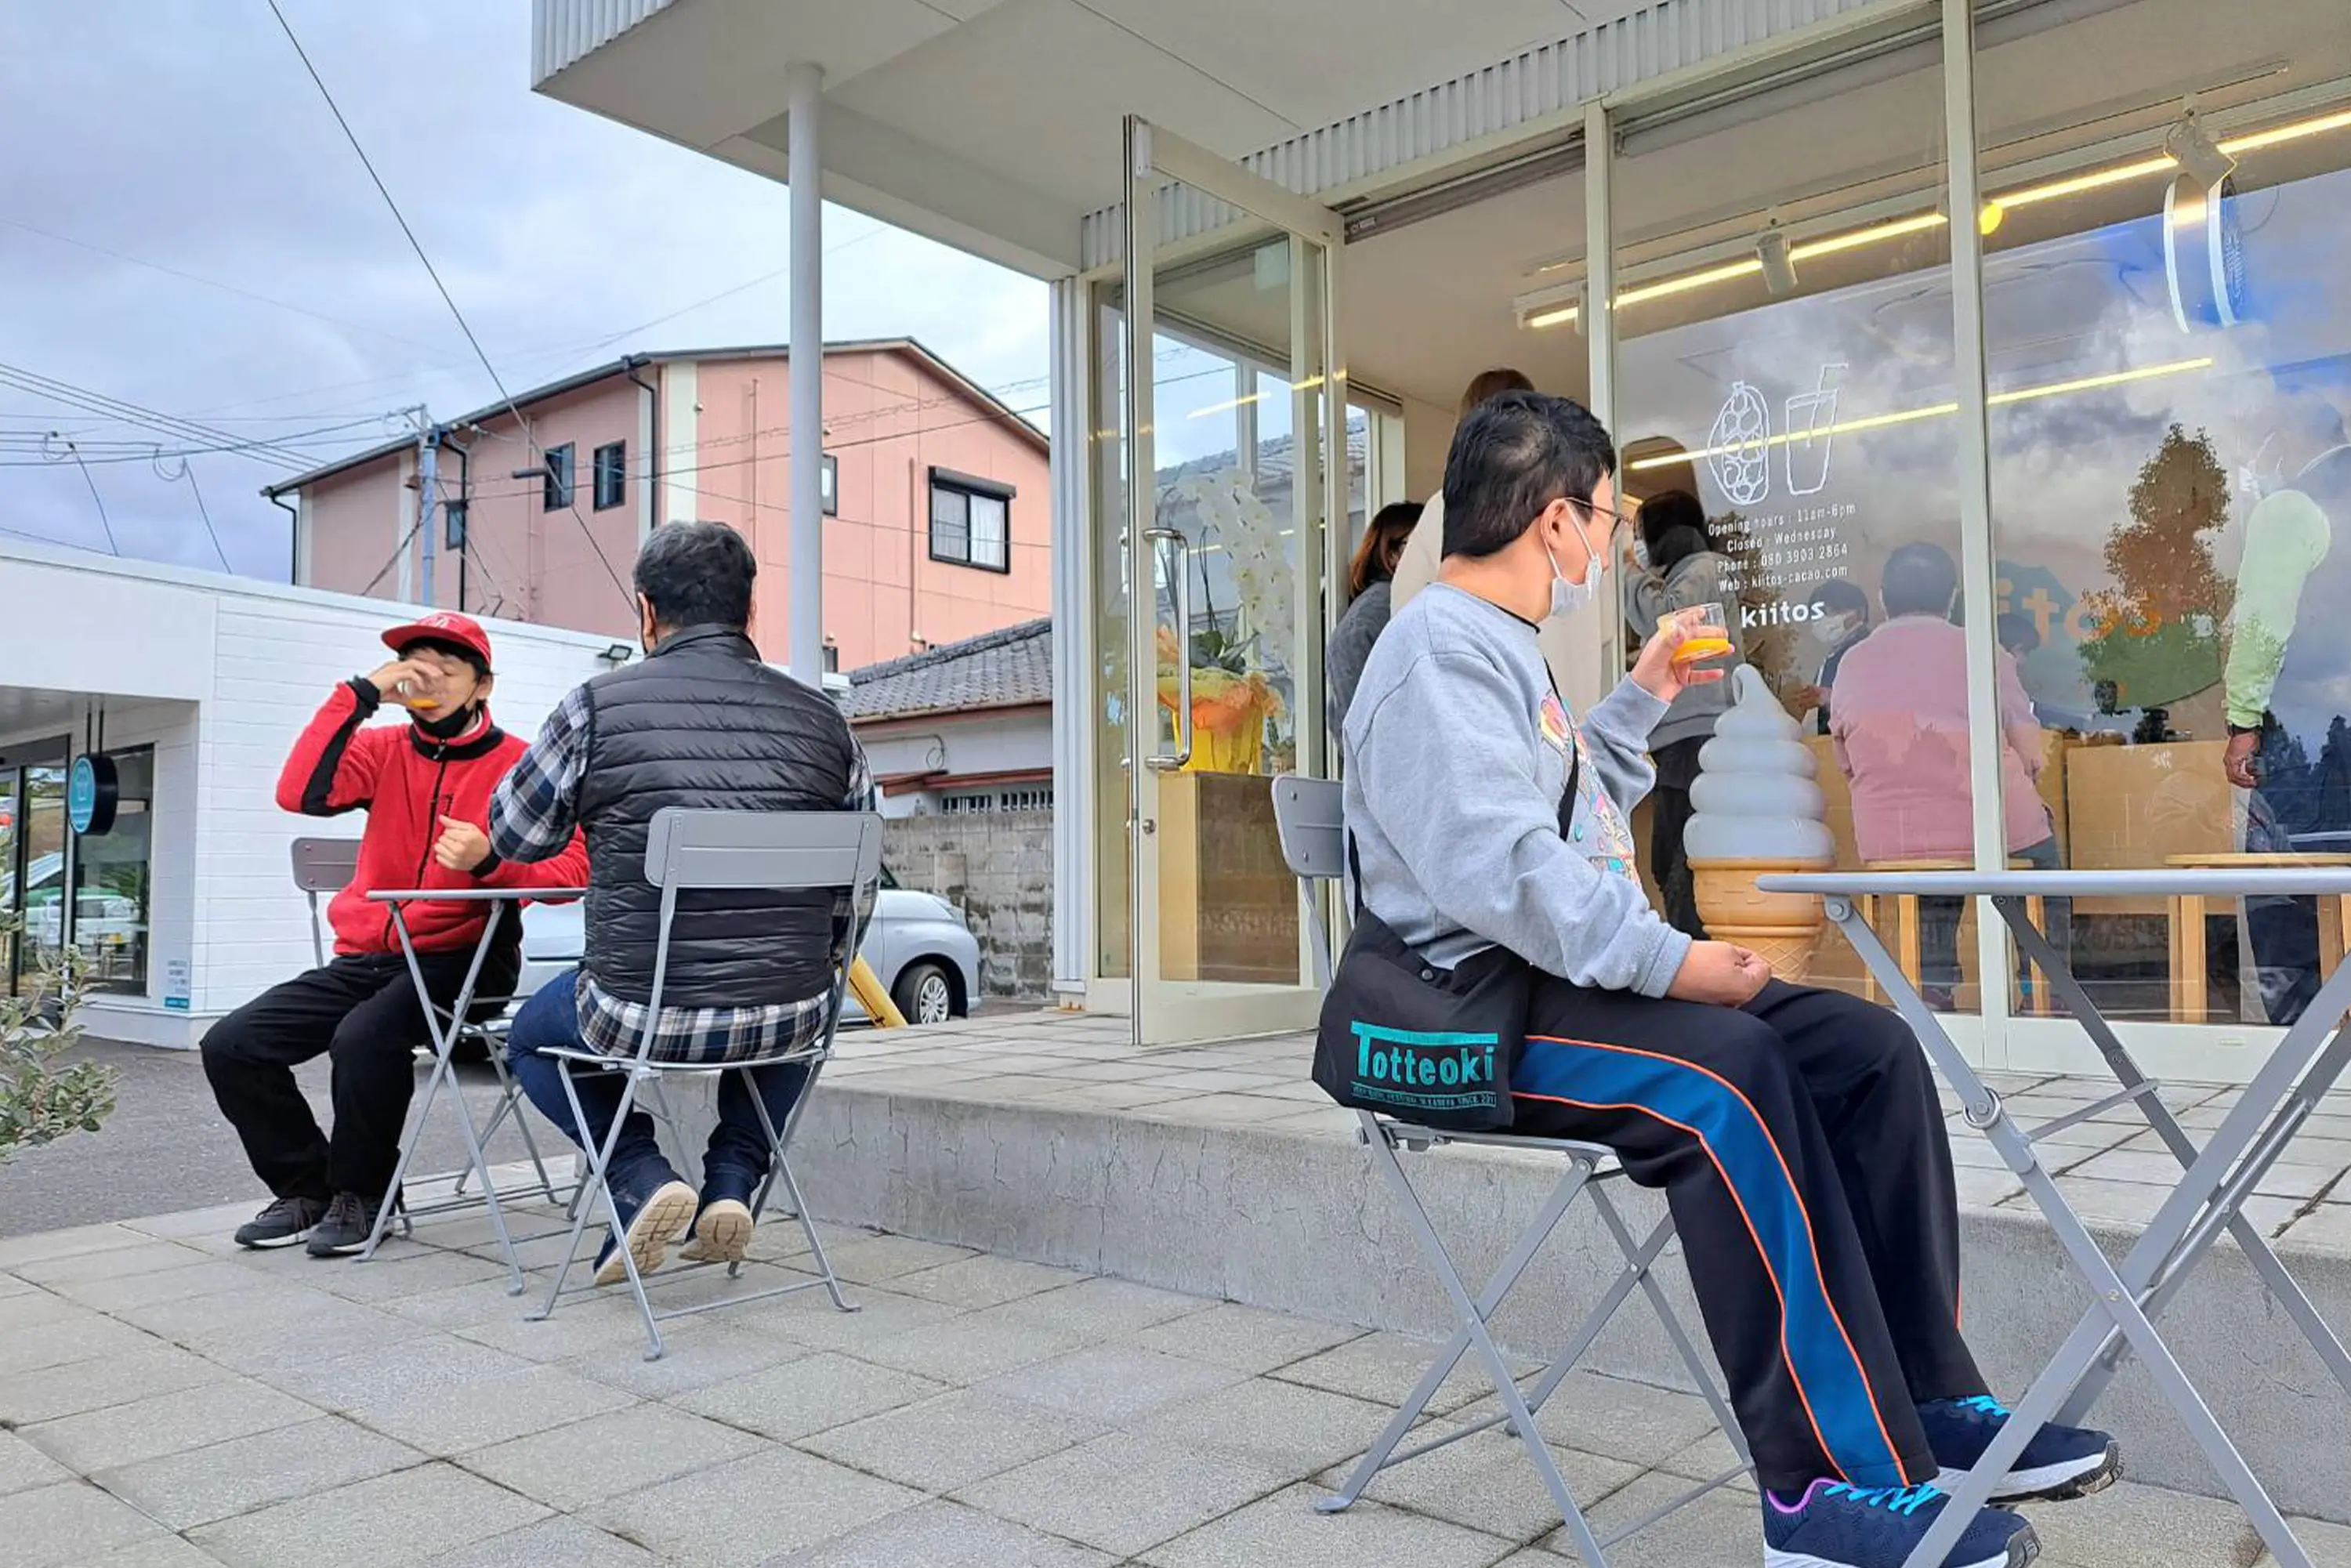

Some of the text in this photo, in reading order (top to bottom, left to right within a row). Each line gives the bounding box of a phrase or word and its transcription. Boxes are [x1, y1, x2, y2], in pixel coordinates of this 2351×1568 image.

[1708, 519, 1750, 538] Opening
[1727, 527, 1836, 552] Closed Wednesday
[1717, 559, 1748, 574] Phone
[1761, 552, 1783, 567] 080
[1787, 547, 1814, 564] 3903
[1718, 578, 1741, 592] Web
[1741, 601, 1825, 628] kiitos
[1350, 1020, 1498, 1086] Totteoki
